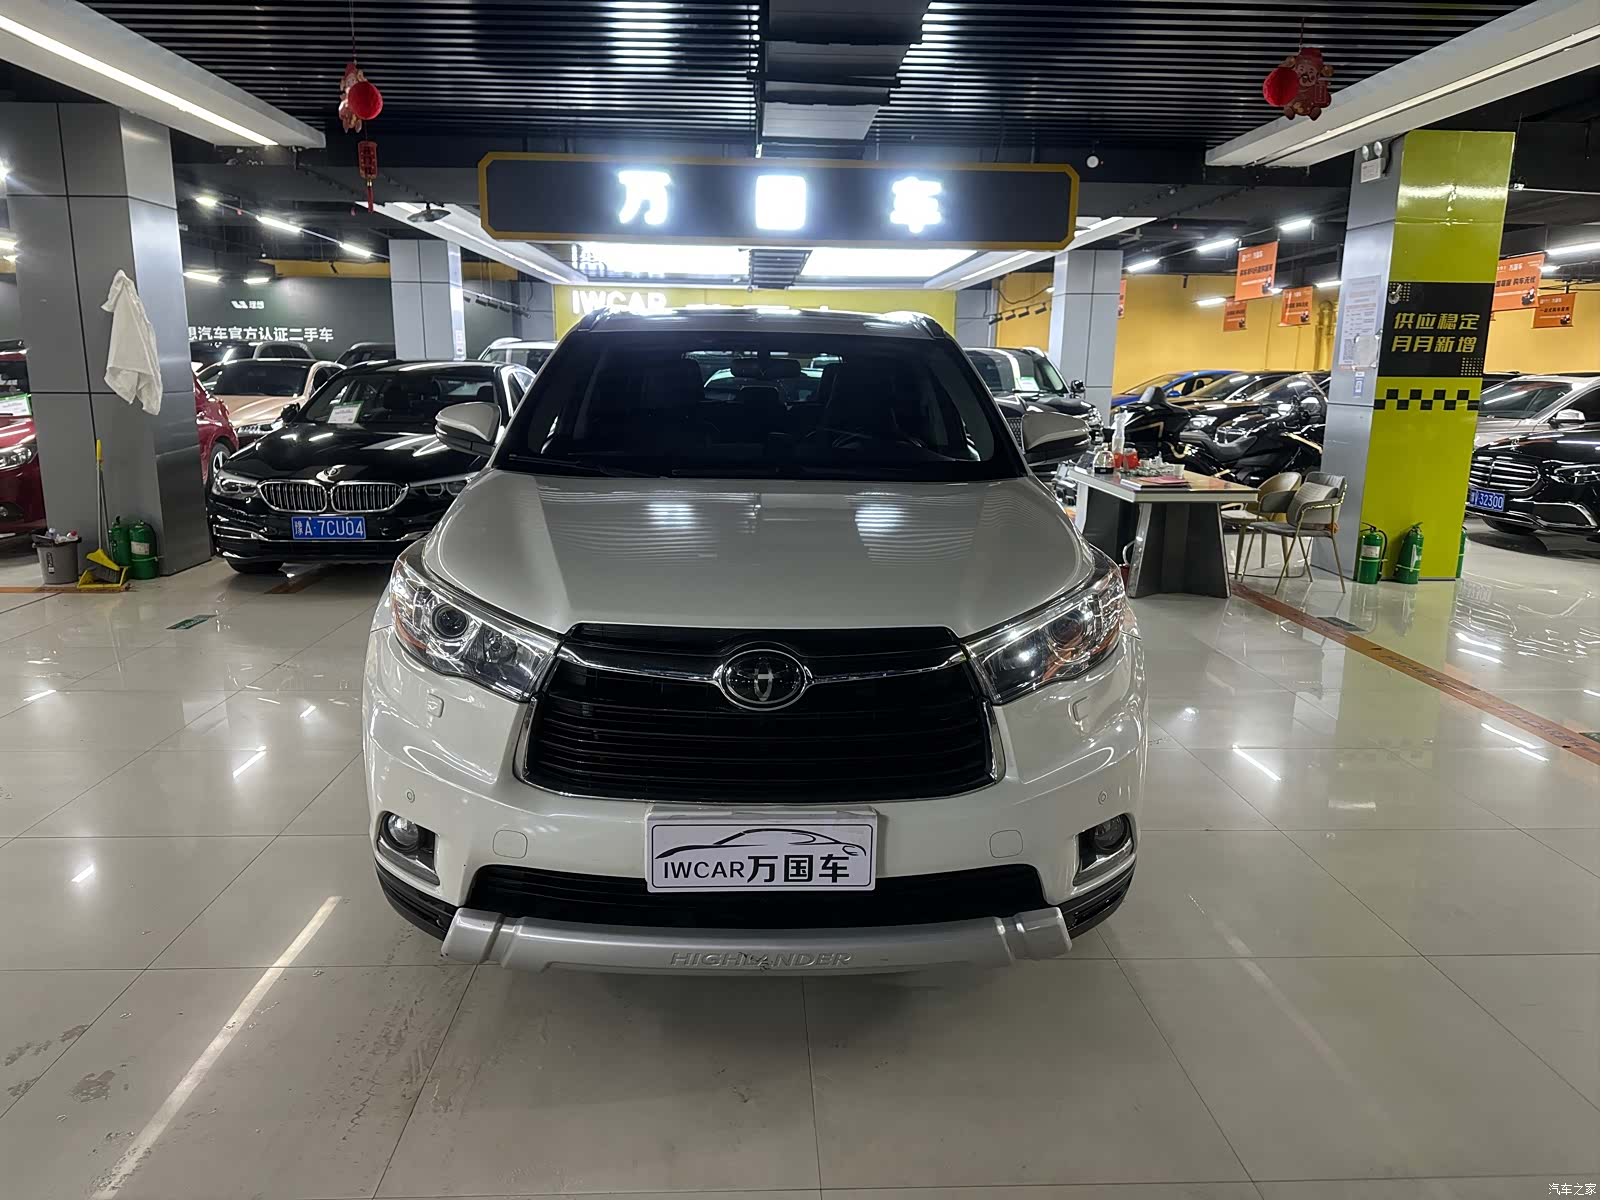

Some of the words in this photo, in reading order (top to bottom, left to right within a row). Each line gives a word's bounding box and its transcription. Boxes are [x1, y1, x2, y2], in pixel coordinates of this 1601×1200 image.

[1393, 313, 1480, 330] 供应稳定
[1391, 336, 1477, 353] 月月新增
[664, 853, 850, 883] IWCAR万国车
[670, 952, 852, 967] HIGHLANDER
